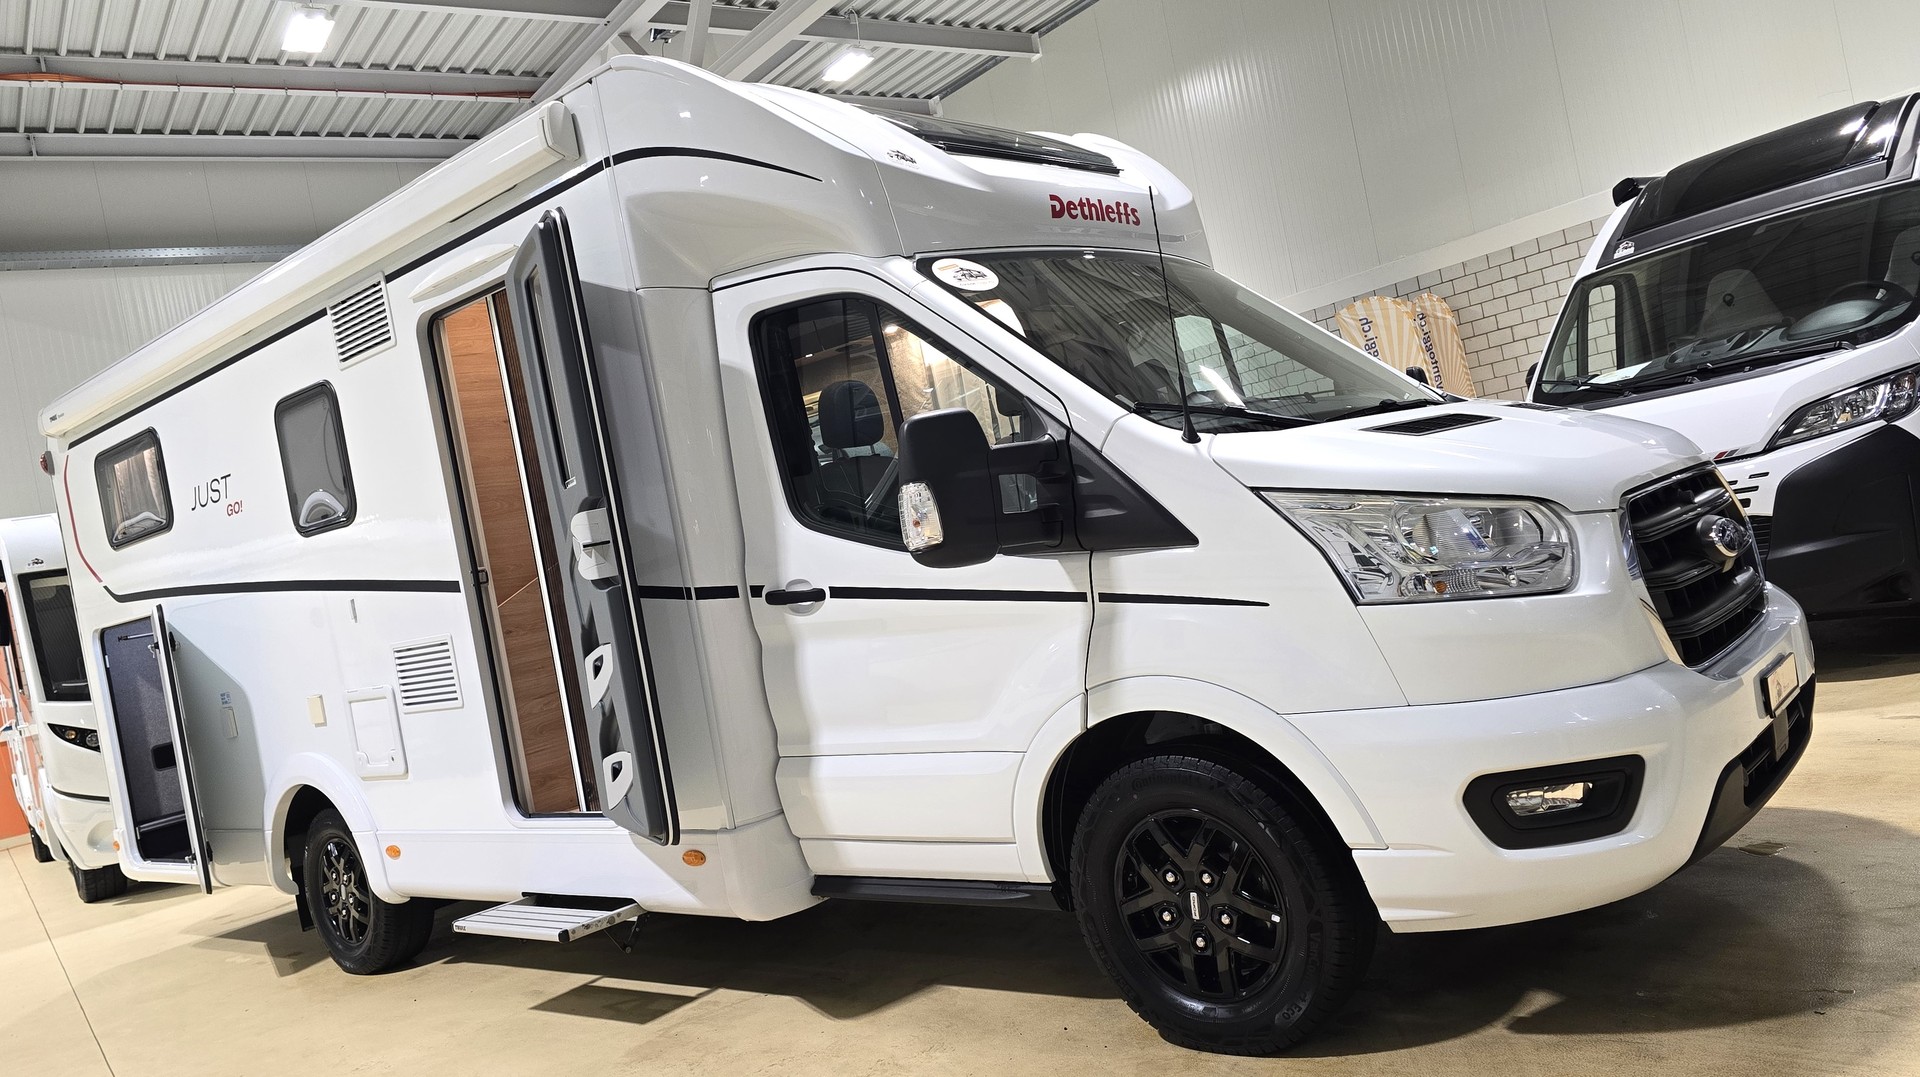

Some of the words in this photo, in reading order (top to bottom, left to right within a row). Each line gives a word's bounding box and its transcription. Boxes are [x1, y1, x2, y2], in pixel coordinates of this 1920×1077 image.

[1049, 194, 1141, 226] Dethleffs
[191, 473, 231, 511] JUST
[226, 500, 243, 517] GO!
